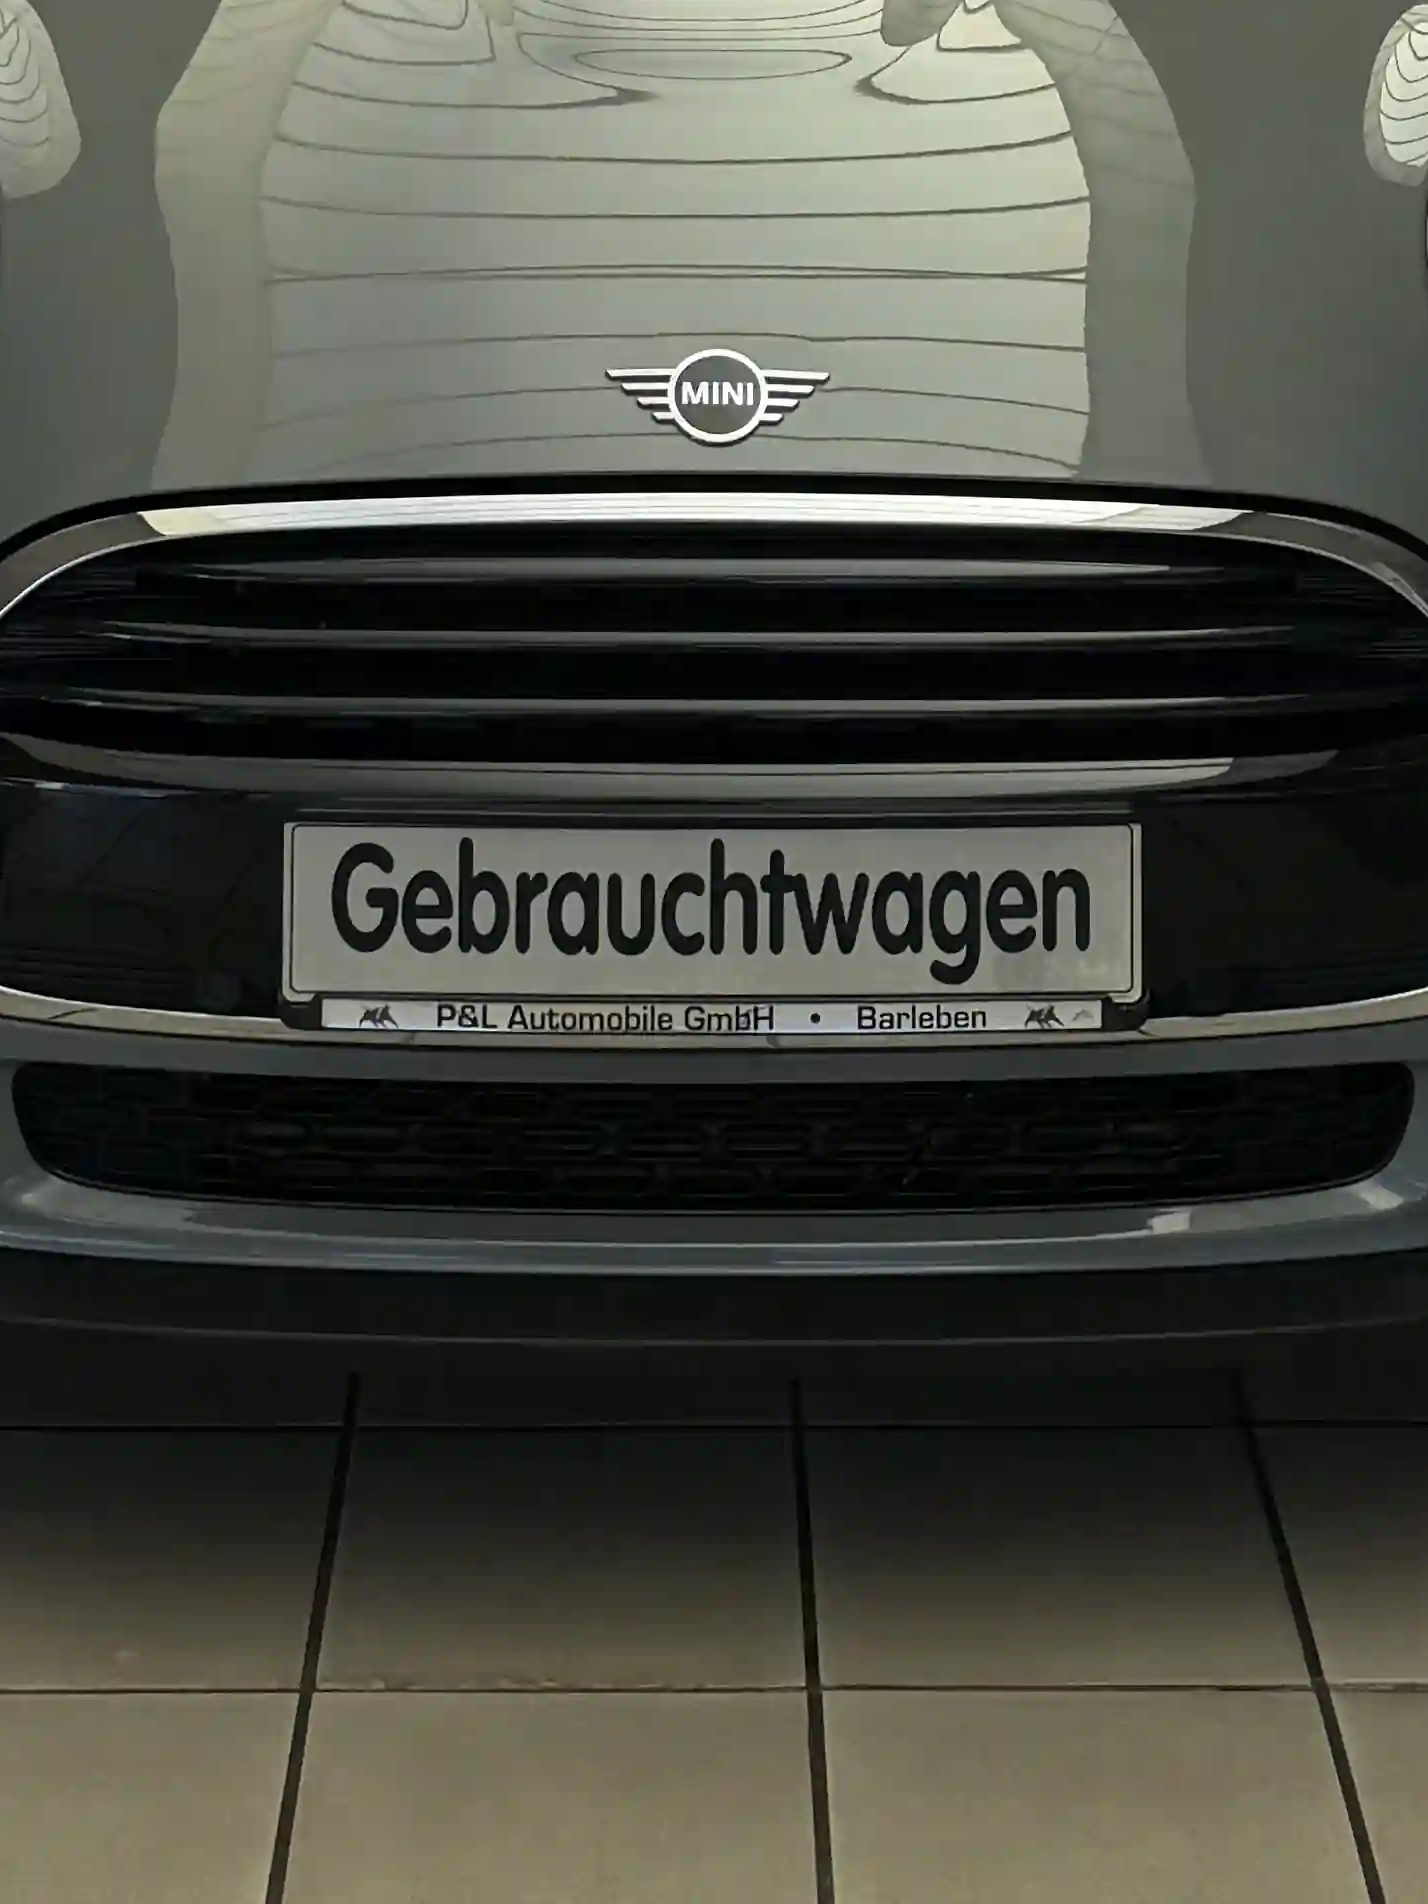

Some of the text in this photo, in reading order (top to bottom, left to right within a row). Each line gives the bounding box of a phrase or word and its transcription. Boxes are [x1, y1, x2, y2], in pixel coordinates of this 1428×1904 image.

[681, 381, 754, 406] MINI
[330, 837, 1091, 986] Gebrauchtwagen
[437, 1003, 987, 1032] P&L Automobile GmbH Barleben
